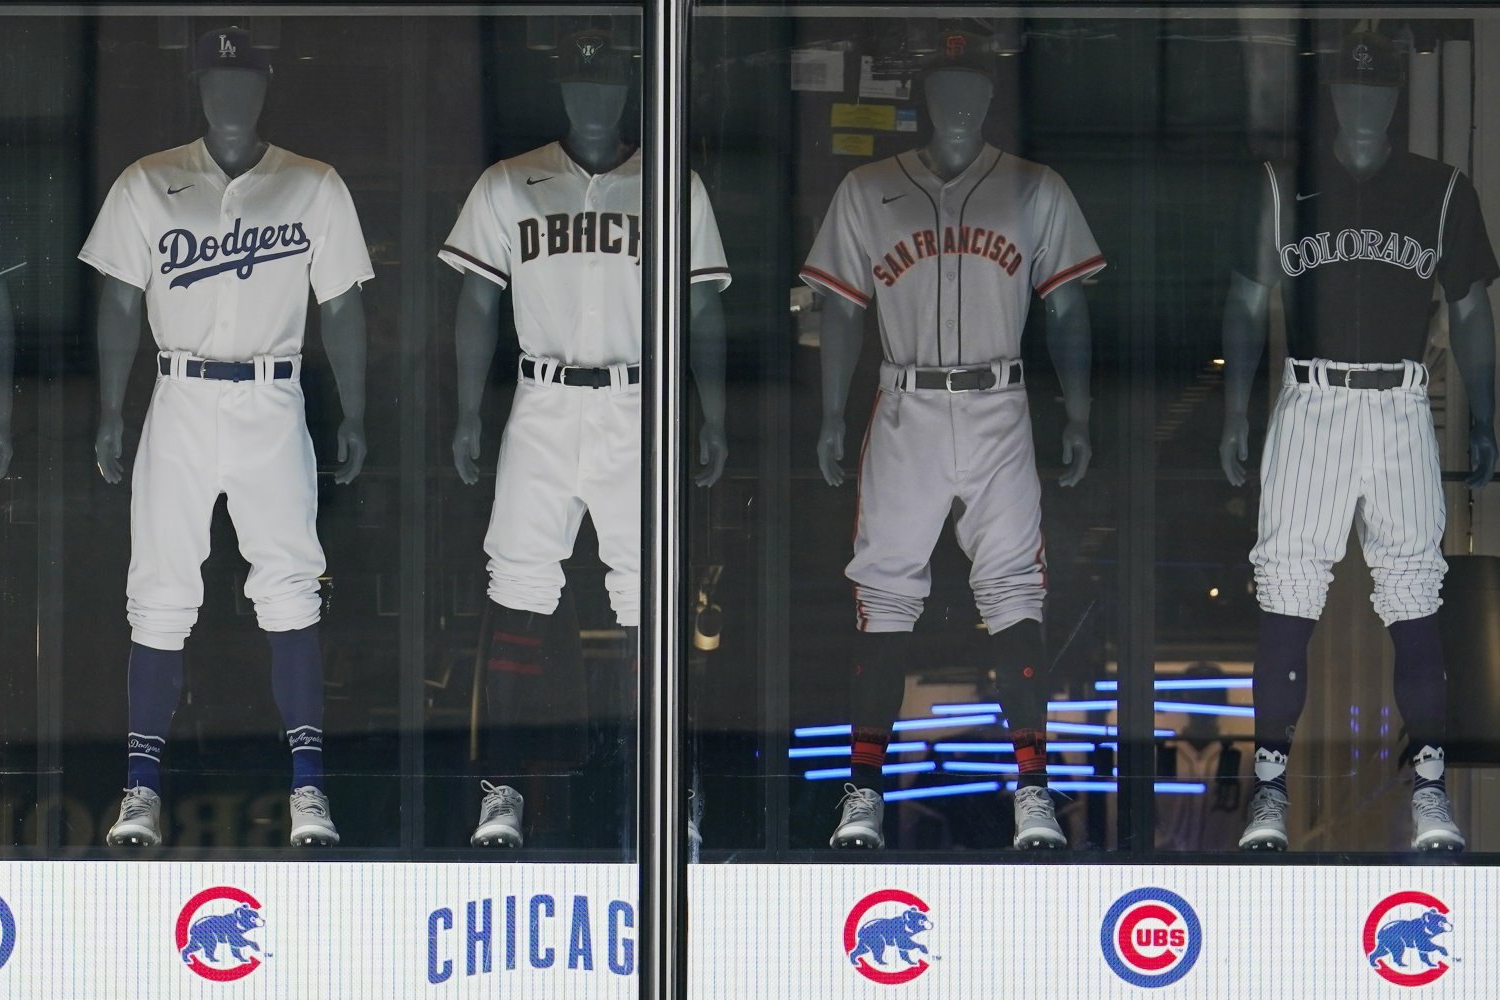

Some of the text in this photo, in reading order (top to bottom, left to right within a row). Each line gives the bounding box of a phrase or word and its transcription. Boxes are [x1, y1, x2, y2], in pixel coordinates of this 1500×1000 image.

[159, 218, 310, 283] Dodgers
[873, 226, 1023, 287] SAN FRANCISCO
[1280, 229, 1437, 279] COLORADO
[426, 894, 637, 984] CHICAG
